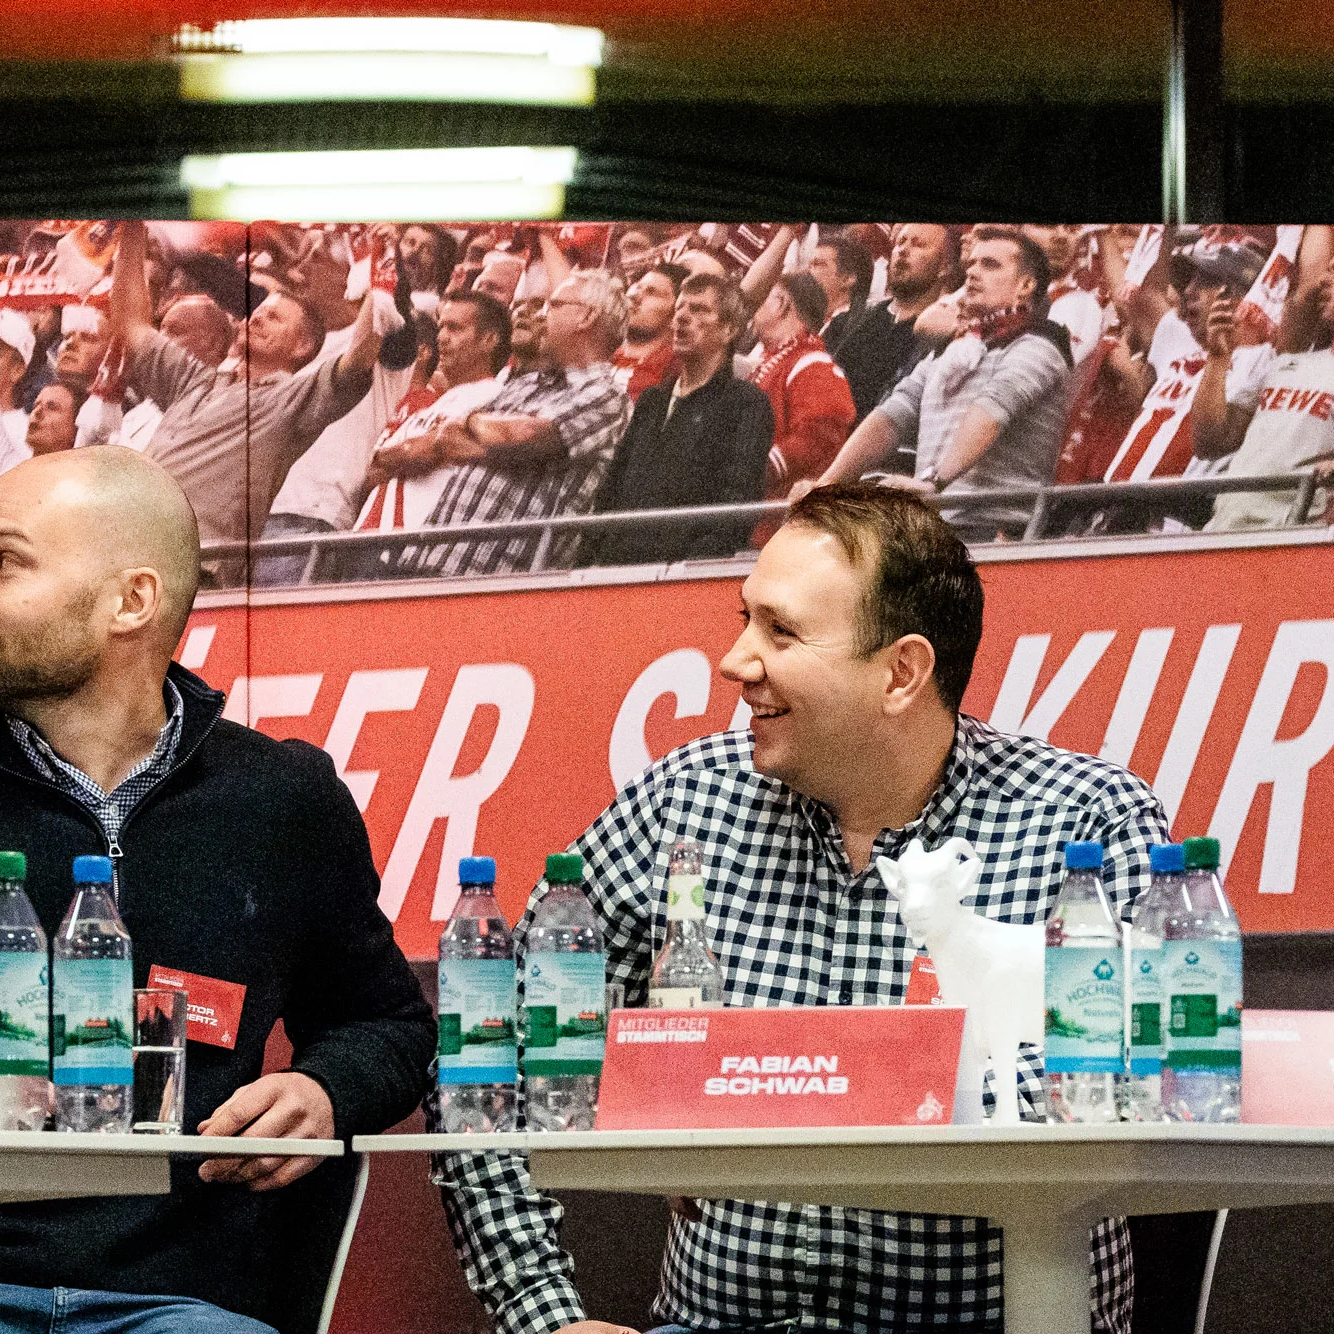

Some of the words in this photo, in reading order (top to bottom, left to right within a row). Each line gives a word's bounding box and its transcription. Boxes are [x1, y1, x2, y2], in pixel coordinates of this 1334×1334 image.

[617, 1017, 709, 1032] MITGLIEDER
[720, 1055, 839, 1074] FABIAN
[704, 1076, 850, 1095] SCHWAB
